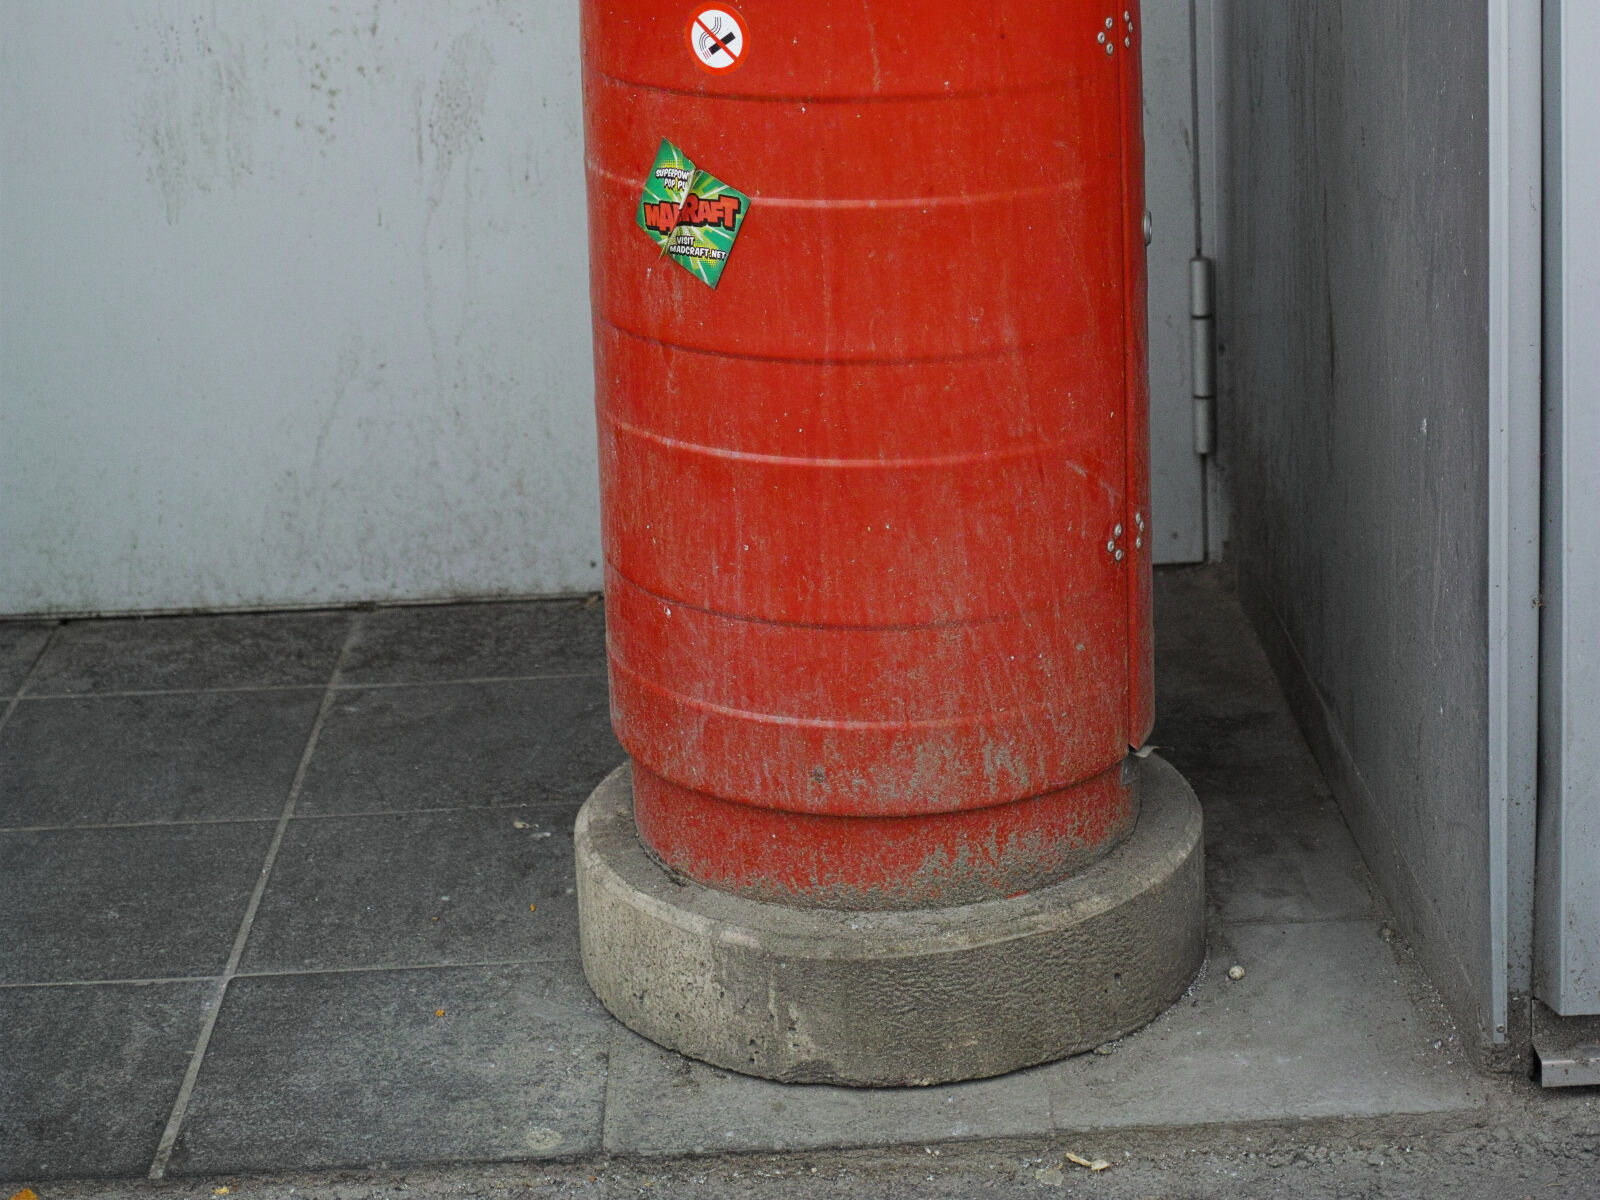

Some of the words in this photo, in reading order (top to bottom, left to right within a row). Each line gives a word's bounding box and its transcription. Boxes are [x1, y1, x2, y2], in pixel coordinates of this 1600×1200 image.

[664, 178, 676, 188] POP
[676, 235, 695, 246] VISIT
[669, 244, 727, 260] MADCRAFT.NET
